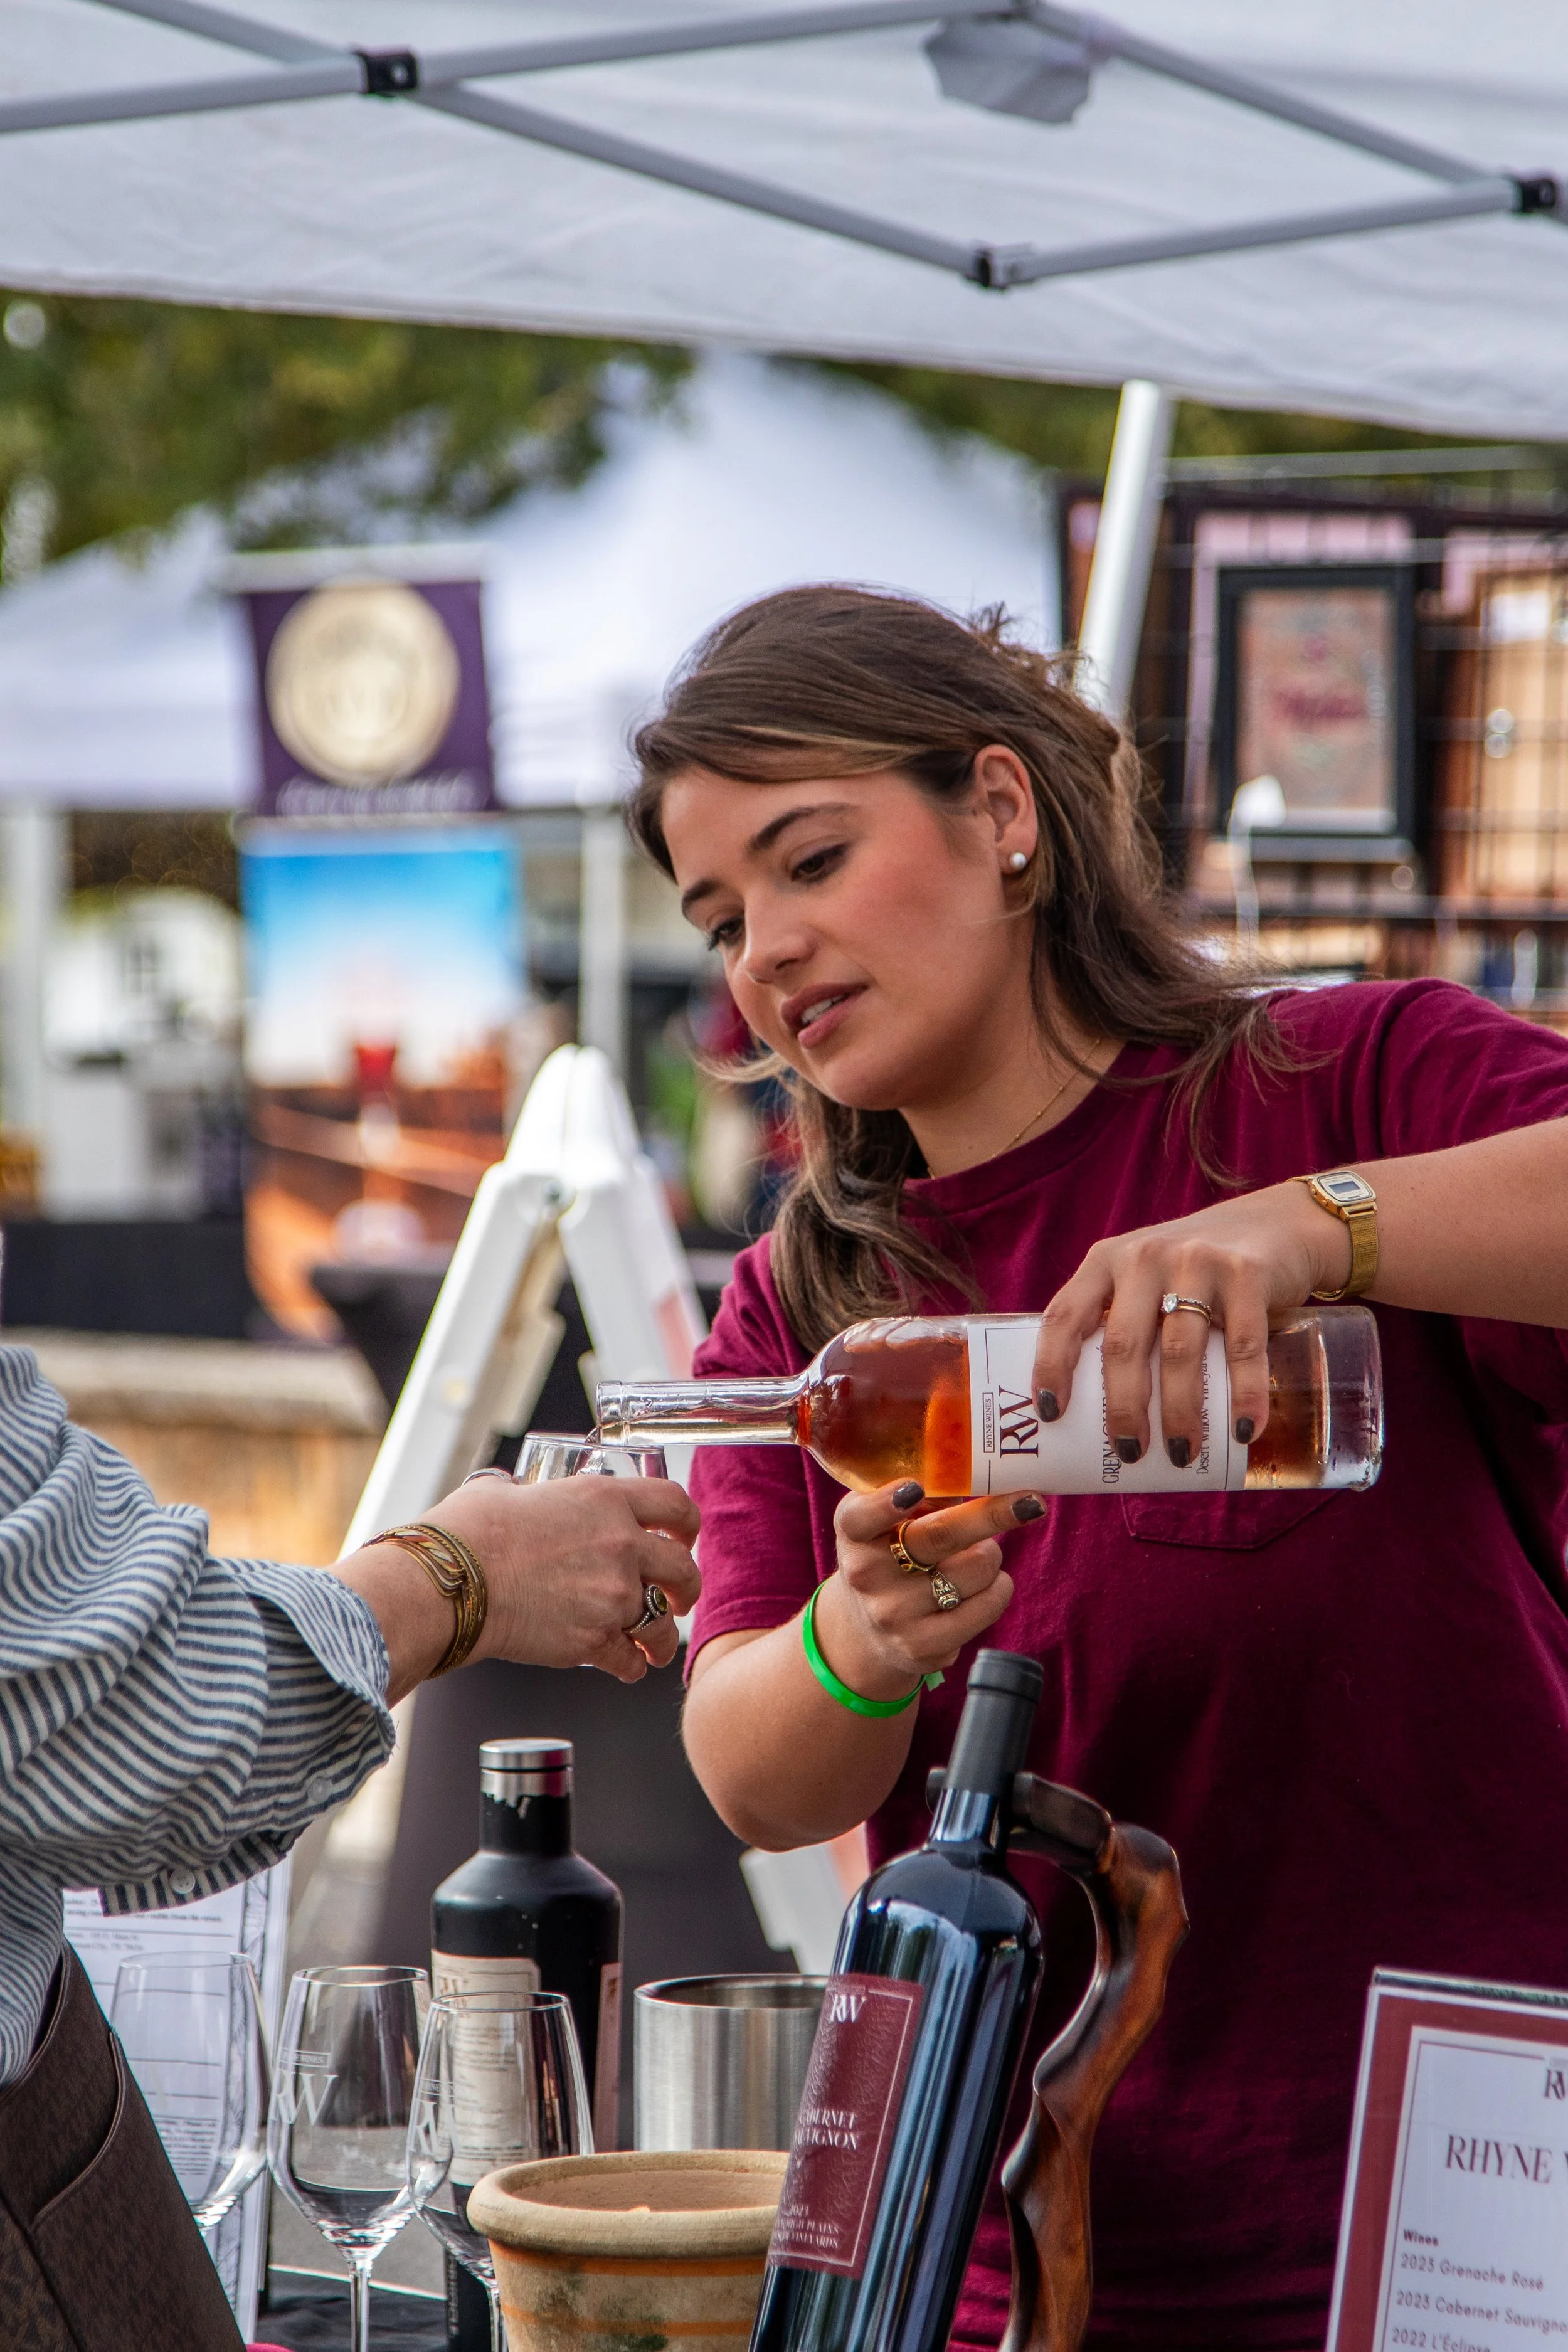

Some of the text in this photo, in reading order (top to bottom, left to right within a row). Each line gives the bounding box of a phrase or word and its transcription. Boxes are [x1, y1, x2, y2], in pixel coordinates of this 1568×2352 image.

[999, 1385, 1039, 1458] RW
[829, 1994, 867, 2023] RW
[1446, 2134, 1552, 2184] RHYNE
[1404, 2228, 1439, 2247] Wines
[1401, 2252, 1544, 2291] 2023 Grenache Rosé
[1397, 2289, 1431, 2311] 2023
[1436, 2296, 1500, 2322] Cabernet
[1392, 2327, 1427, 2349] 2022
